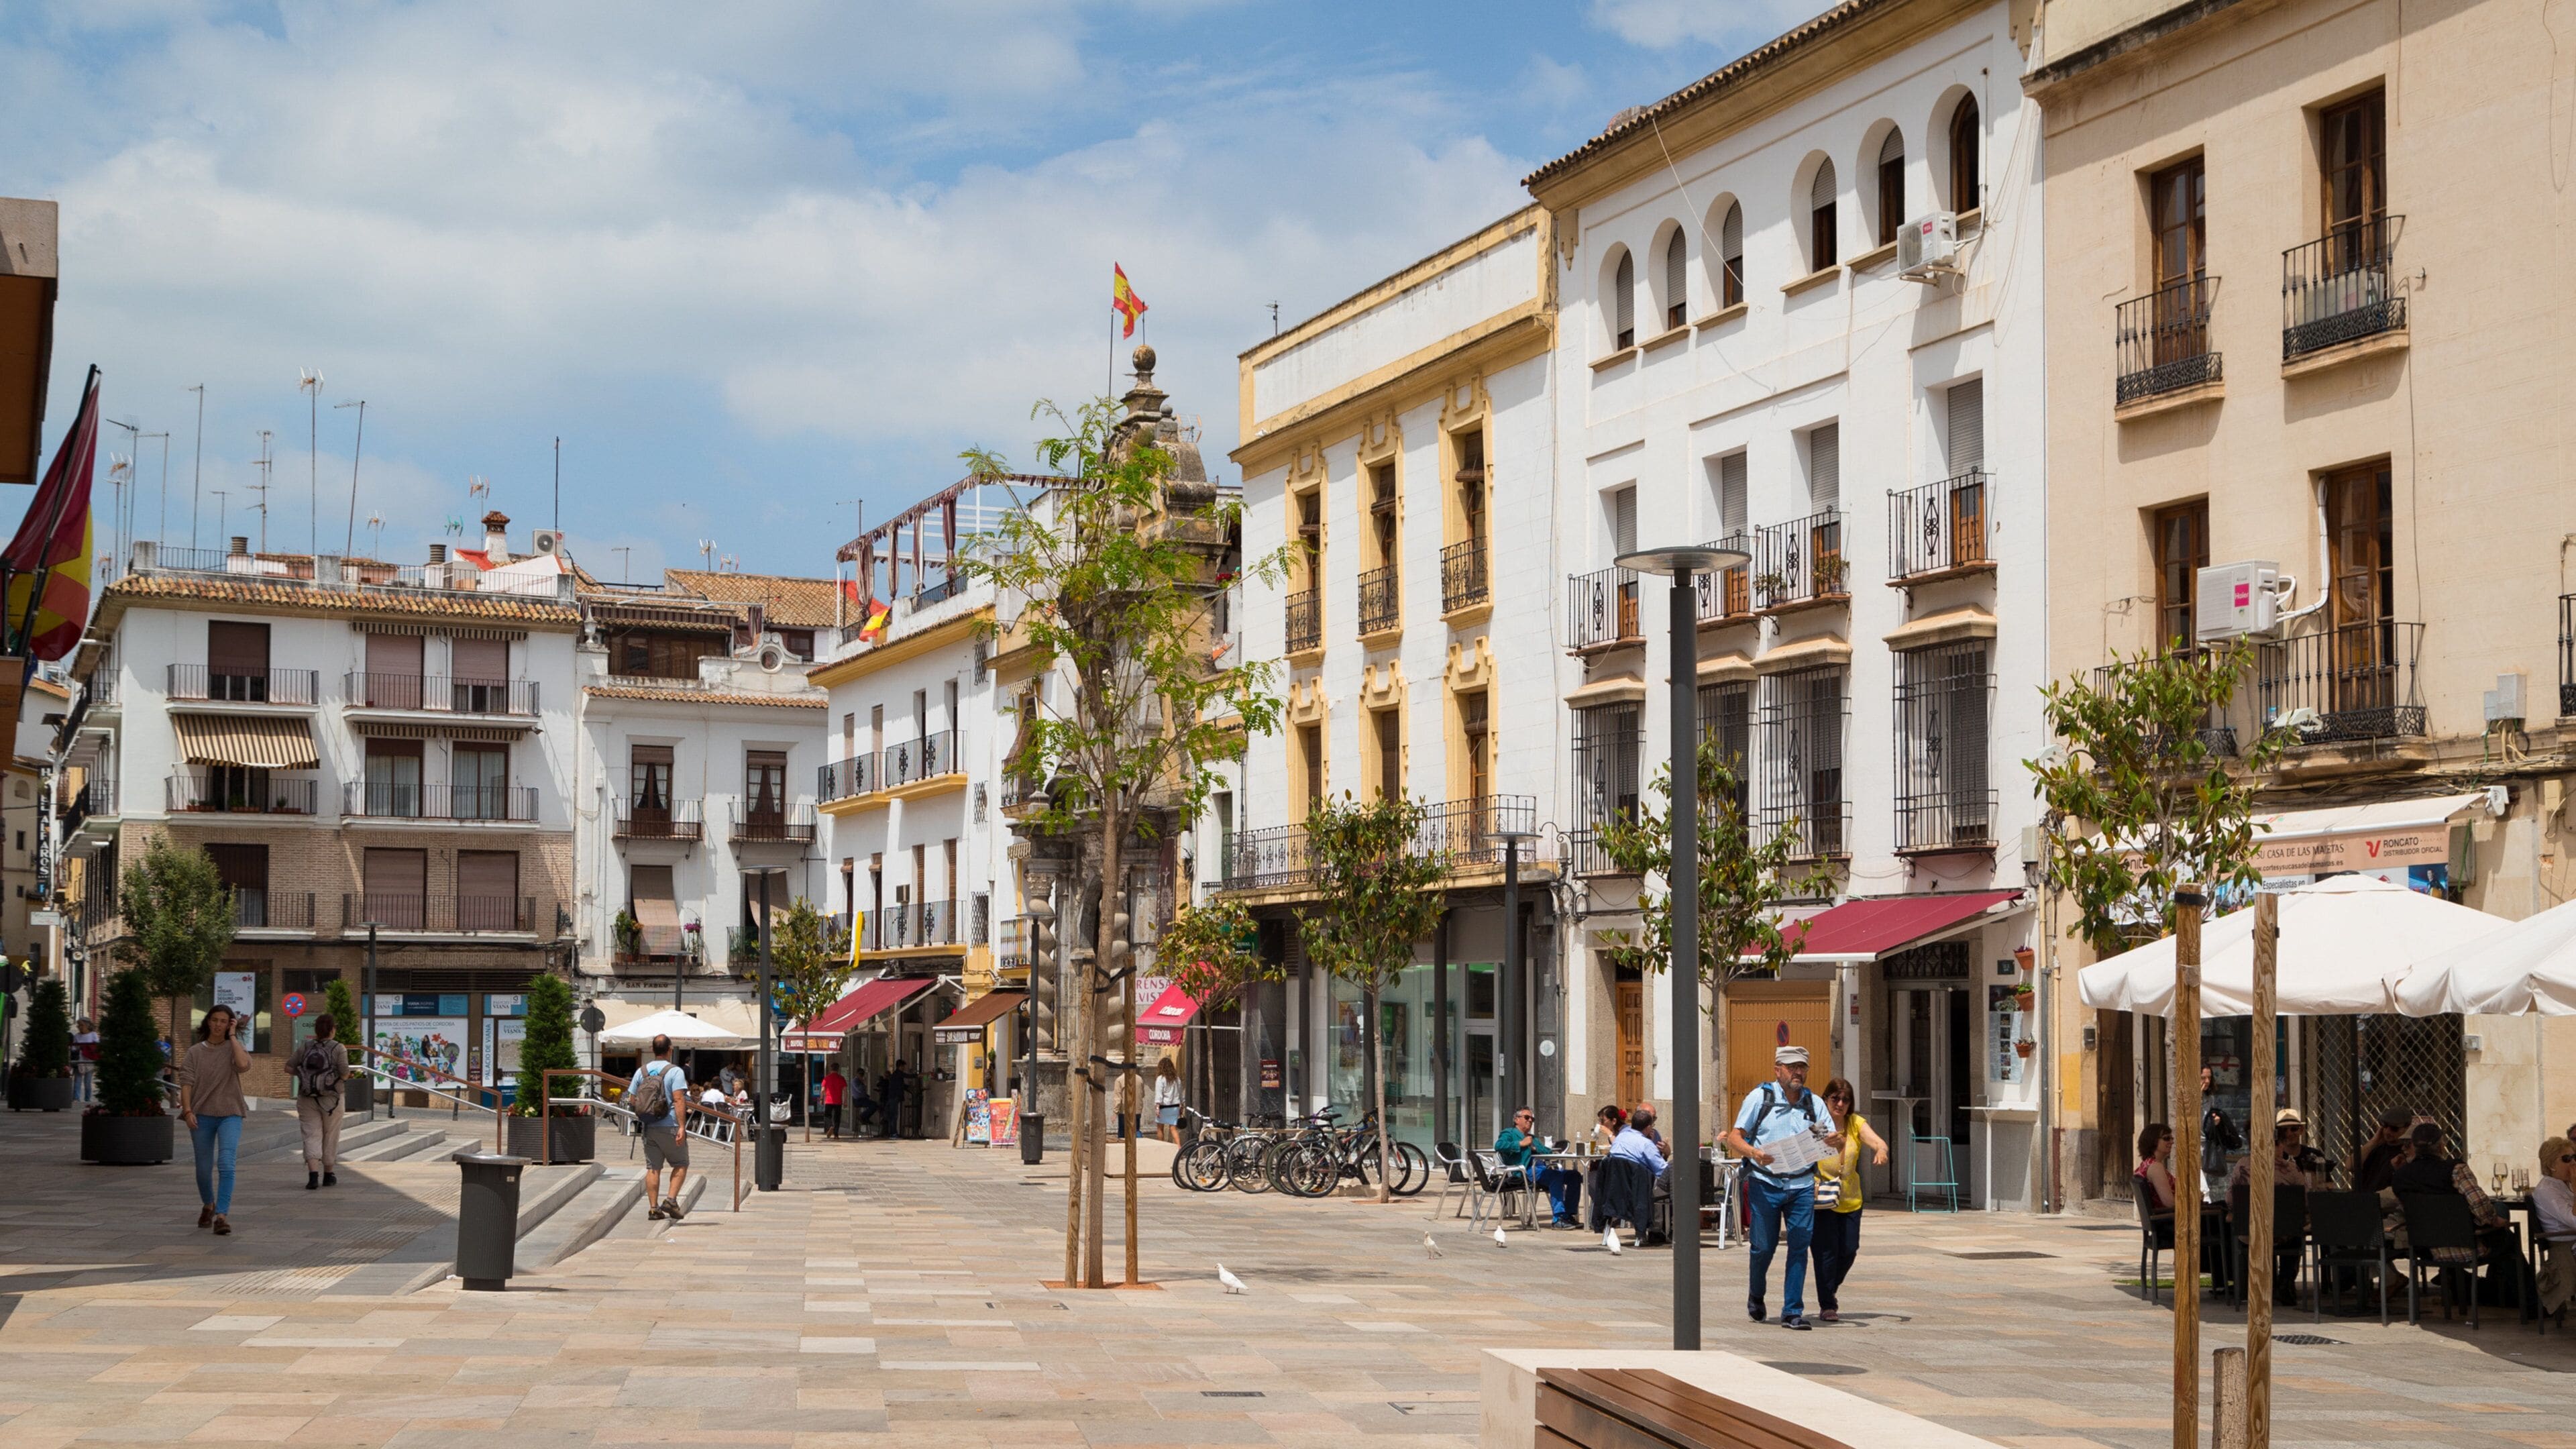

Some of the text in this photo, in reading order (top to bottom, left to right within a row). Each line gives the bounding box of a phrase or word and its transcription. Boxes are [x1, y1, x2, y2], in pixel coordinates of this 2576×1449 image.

[2235, 591, 2249, 599] Haier
[2383, 837, 2420, 849] RONCATO
[2267, 848, 2285, 859] CASA
[2286, 847, 2296, 857] DE
[2298, 846, 2311, 857] LAS
[2383, 846, 2444, 857] DISTRIBUIDOR OFICIAL
[2263, 879, 2306, 892] Especialistas en
[1136, 979, 1171, 989] RENSA
[485, 1044, 492, 1054] DE
